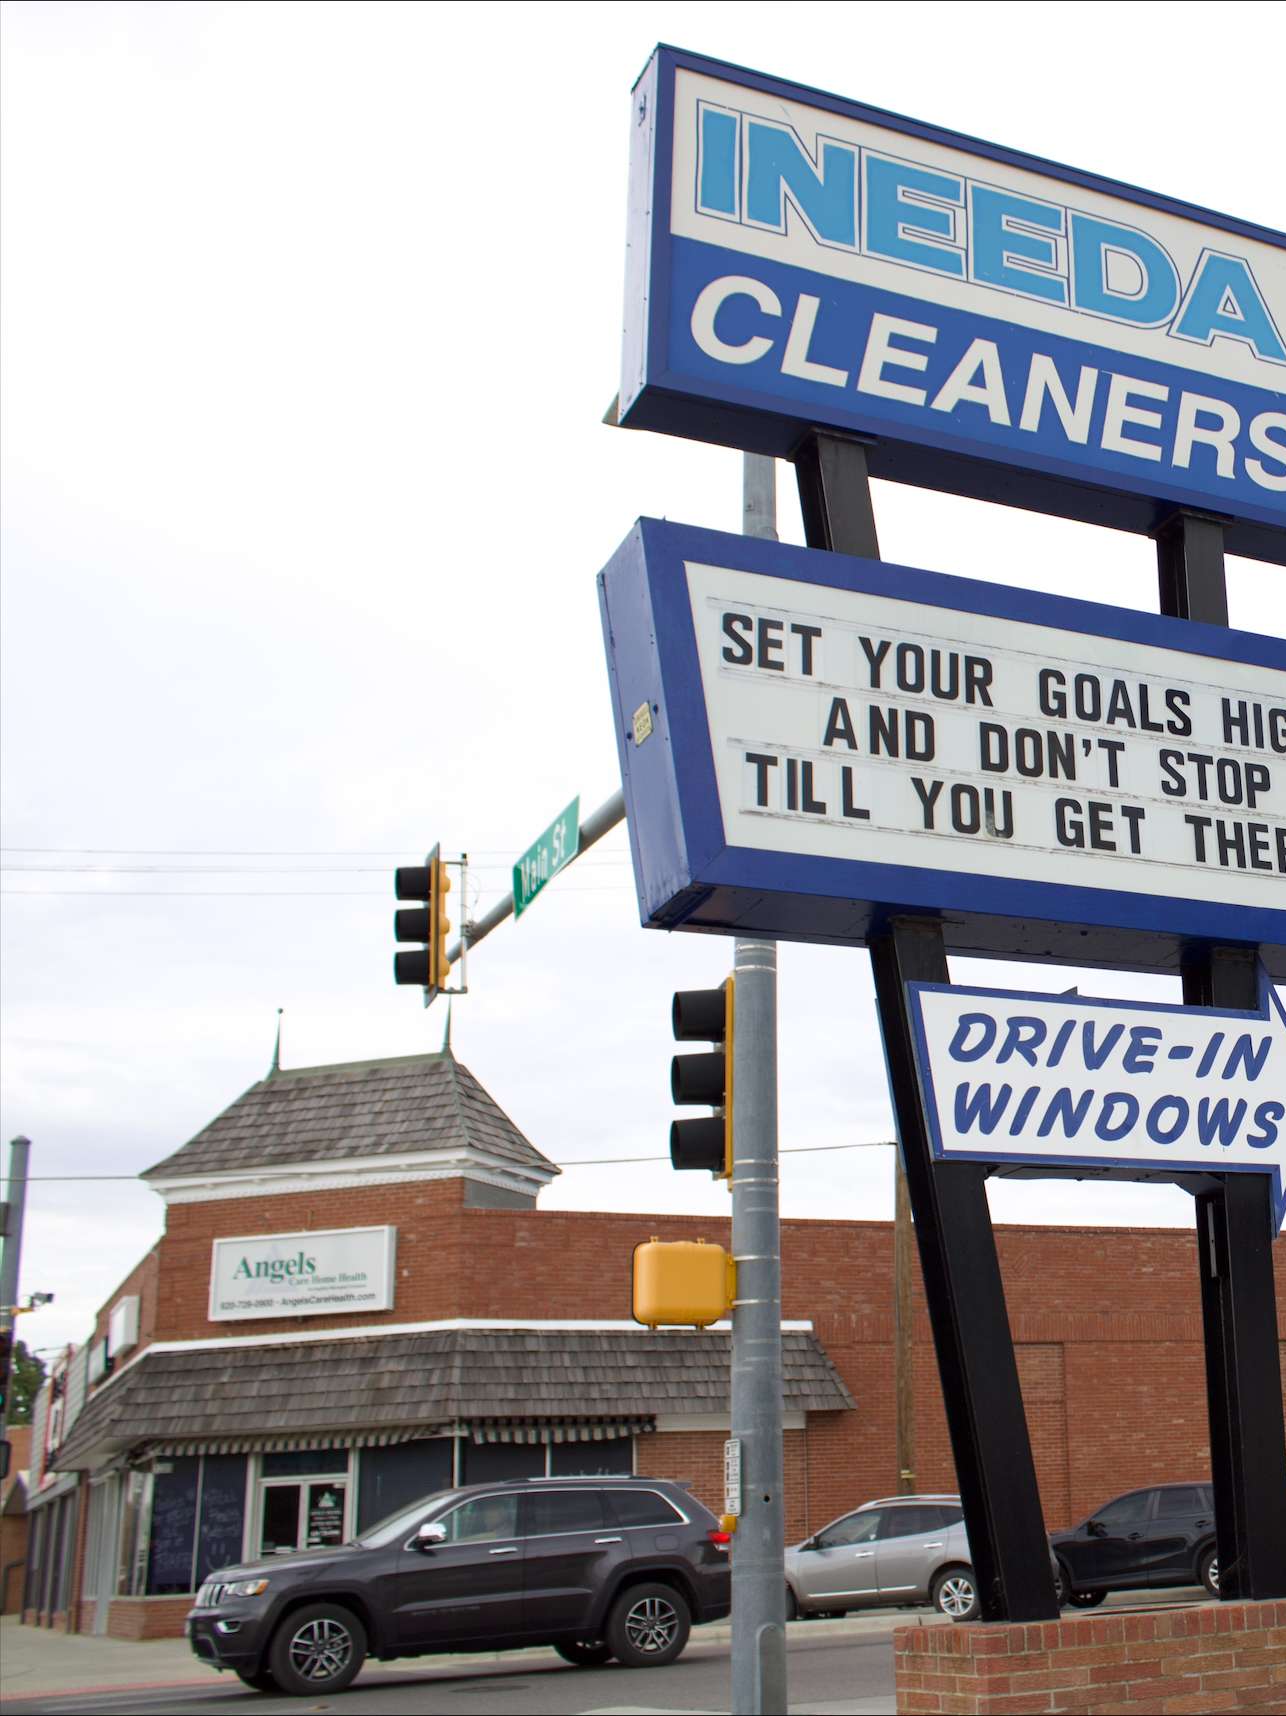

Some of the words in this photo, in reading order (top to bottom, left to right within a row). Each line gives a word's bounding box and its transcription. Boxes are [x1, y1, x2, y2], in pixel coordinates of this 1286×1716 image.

[722, 612, 822, 676] SET
[858, 636, 995, 707] YOUR
[1038, 668, 1193, 737] GOALS
[823, 697, 936, 762] AND
[979, 721, 1126, 788] DON'T
[1159, 748, 1272, 809] STOP
[745, 752, 871, 820] TILL
[910, 777, 1014, 839] YOU
[1054, 797, 1146, 855] GET
[520, 844, 549, 903] Main
[551, 818, 567, 868] St
[948, 1012, 1273, 1081] DRIVE-IN
[954, 1081, 1286, 1149] WINDOWS
[233, 1252, 316, 1284] Angels
[311, 1275, 337, 1285] Home
[339, 1272, 368, 1283] Health
